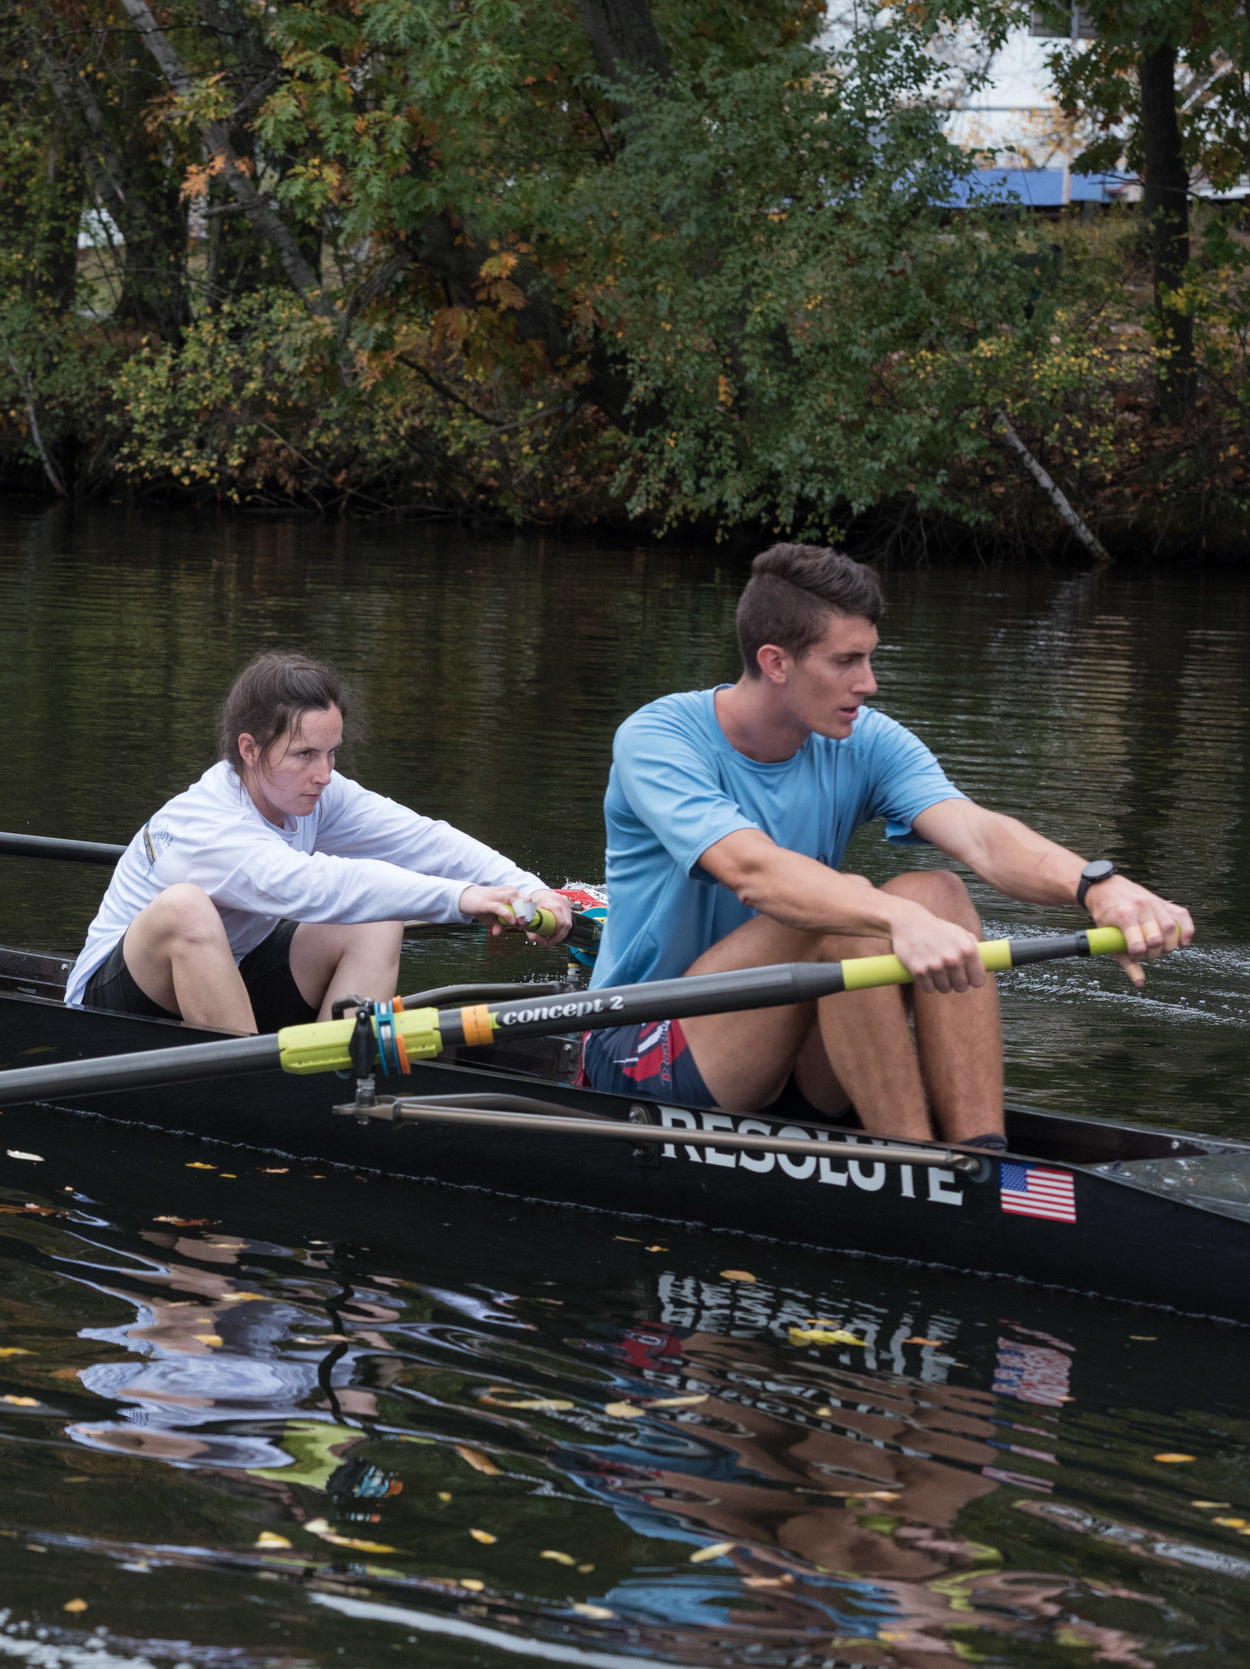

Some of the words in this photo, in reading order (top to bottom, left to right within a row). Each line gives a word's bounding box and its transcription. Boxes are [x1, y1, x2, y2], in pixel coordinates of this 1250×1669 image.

[502, 999, 604, 1025] concept
[610, 995, 624, 1010] 2
[657, 1105, 964, 1206] RESOLUTE
